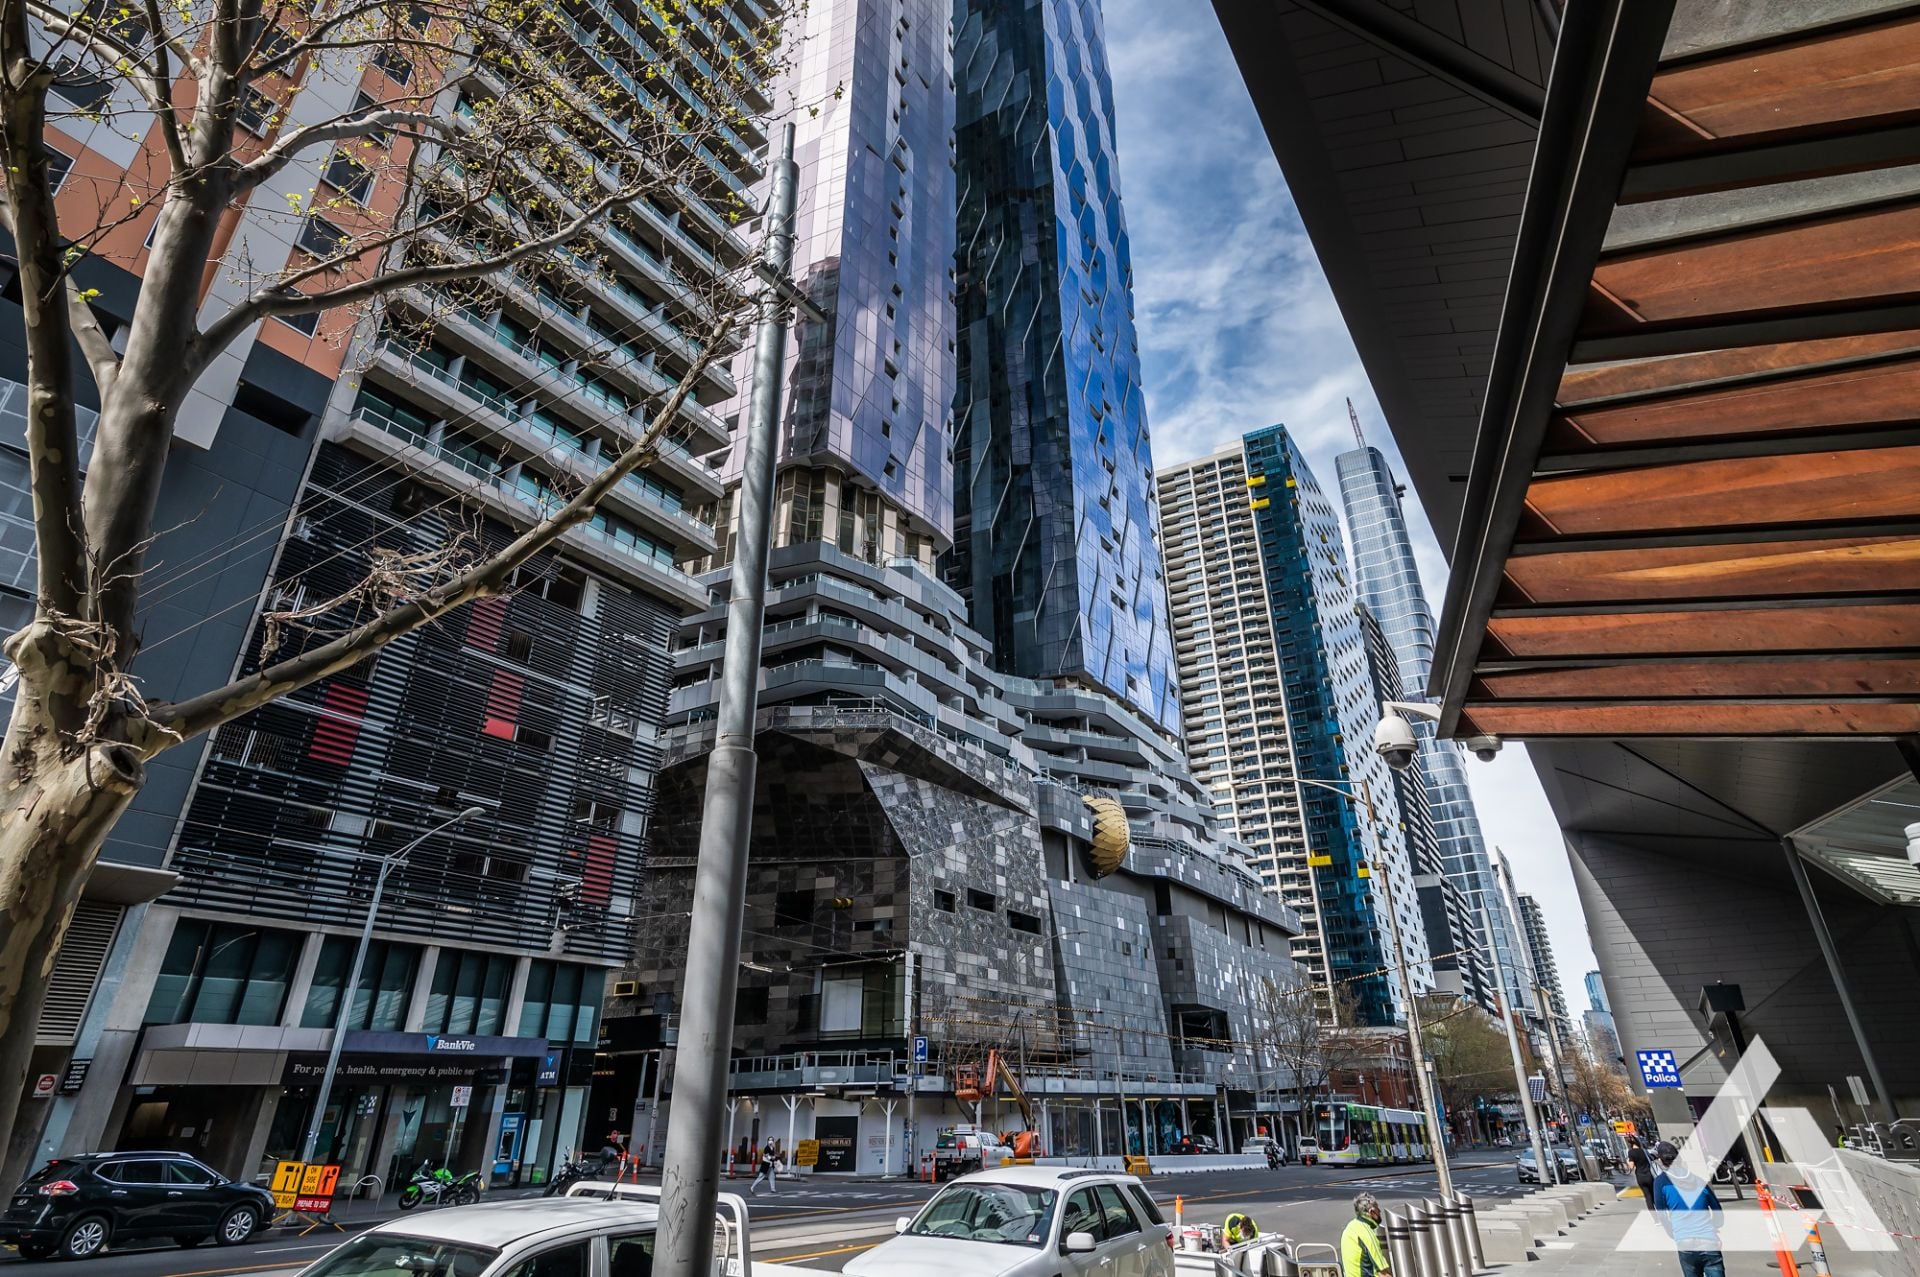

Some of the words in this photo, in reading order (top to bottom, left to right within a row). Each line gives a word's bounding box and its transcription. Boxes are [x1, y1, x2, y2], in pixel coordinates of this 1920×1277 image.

[436, 1039, 475, 1051] BankVic
[916, 1039, 925, 1053] P
[293, 1064, 311, 1074] For
[346, 1065, 378, 1075] health,
[380, 1067, 427, 1077] emergency
[428, 1067, 436, 1075] &
[437, 1067, 463, 1077] public
[540, 1071, 555, 1080] ATM
[1645, 1073, 1678, 1083] Police
